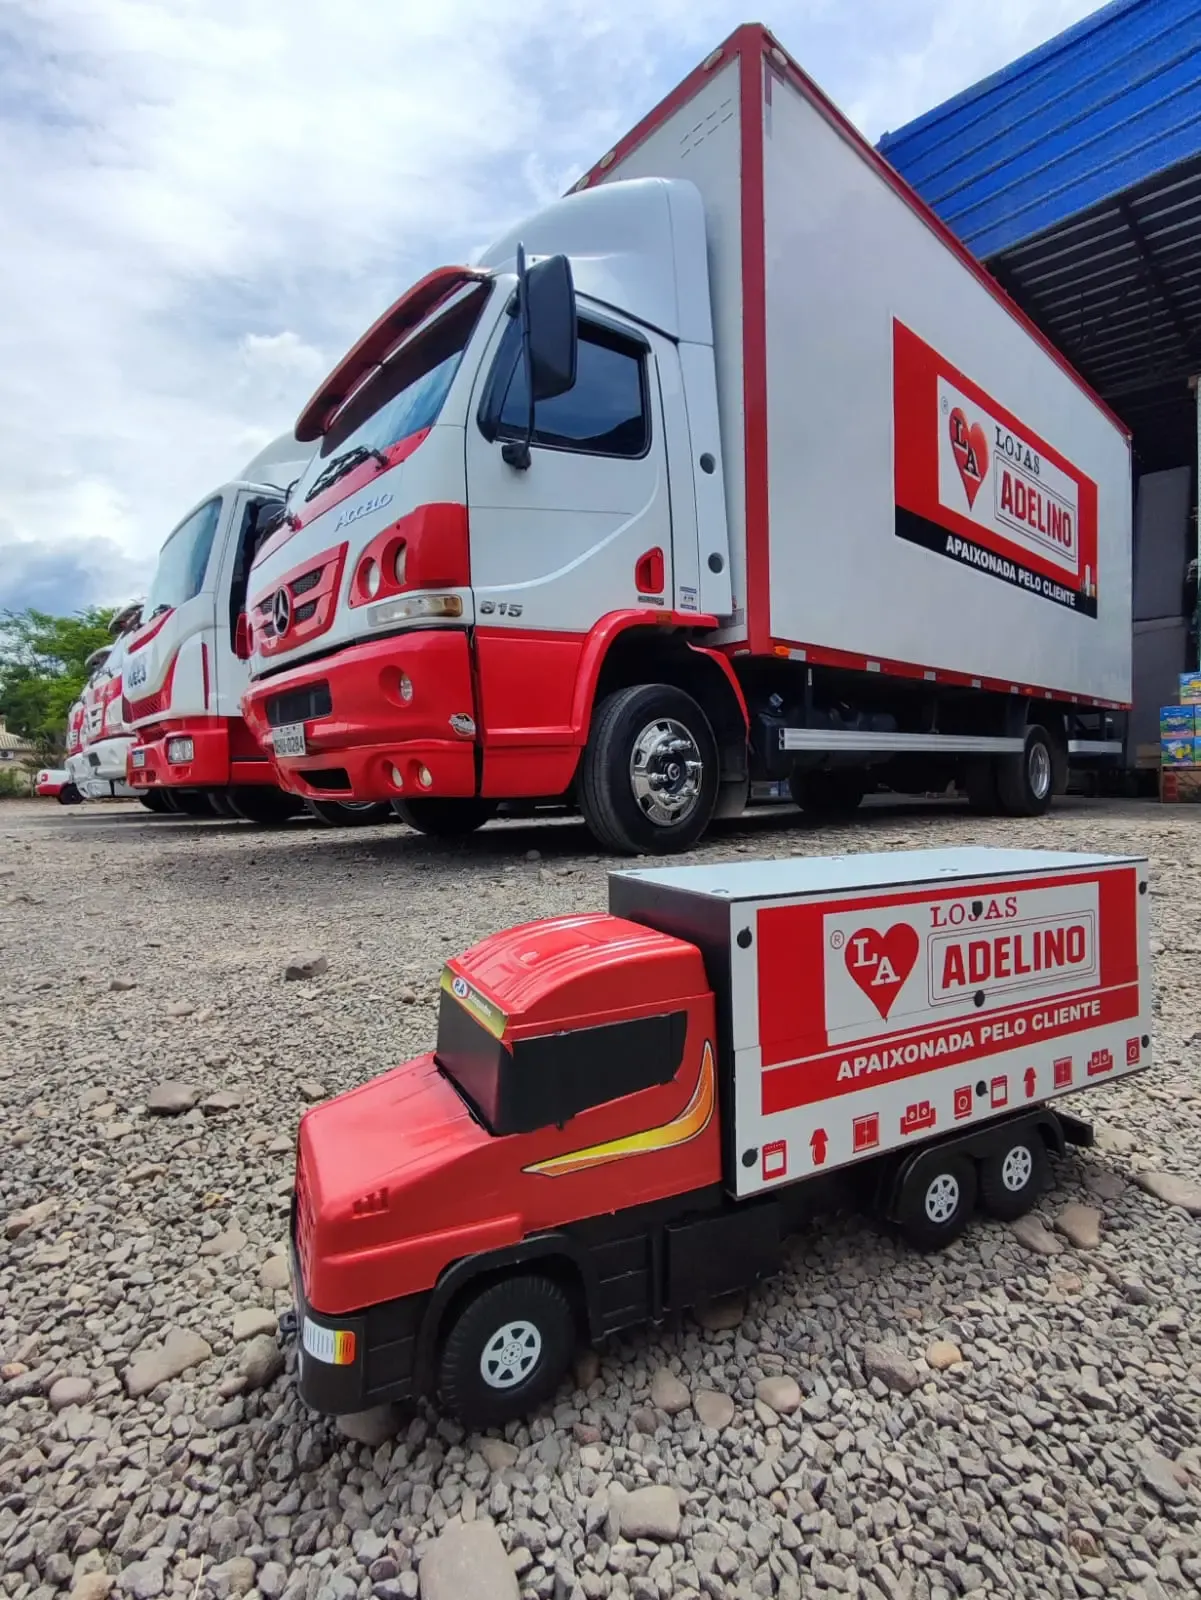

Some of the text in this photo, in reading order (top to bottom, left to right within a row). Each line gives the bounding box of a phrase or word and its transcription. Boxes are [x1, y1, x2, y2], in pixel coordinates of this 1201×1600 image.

[995, 425, 1041, 475] LOJAS
[1001, 470, 1073, 548] ADELINO
[945, 535, 1076, 607] APAIXONADA PELO CLIENTE
[480, 600, 524, 618] 815
[852, 937, 900, 986] LA
[941, 924, 1086, 990] ADELINO
[836, 999, 1102, 1081] APAIXONADA PELO CLIENTE
